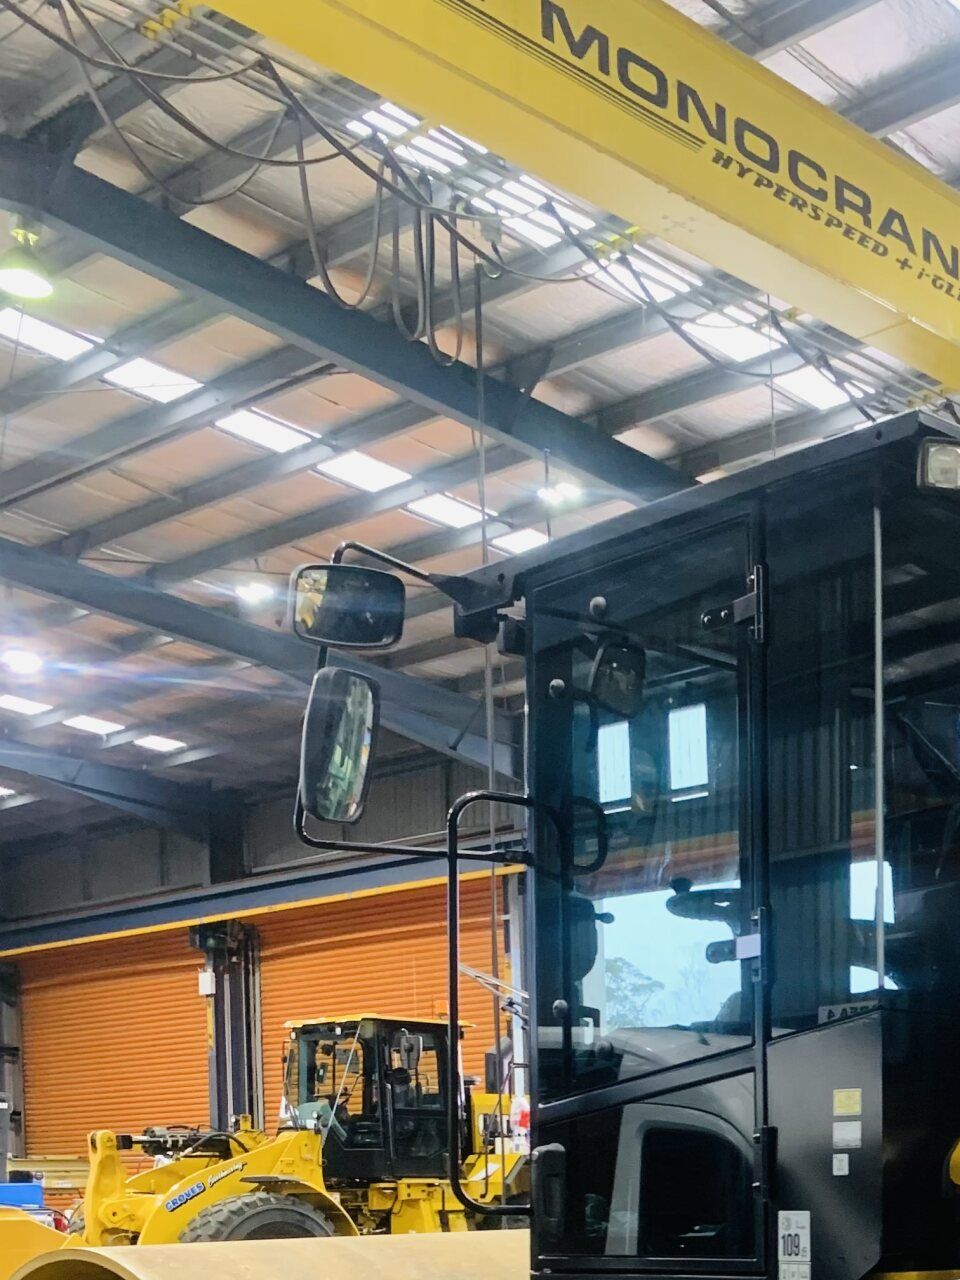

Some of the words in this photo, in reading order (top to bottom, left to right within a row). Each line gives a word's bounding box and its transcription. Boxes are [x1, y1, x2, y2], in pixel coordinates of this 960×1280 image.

[712, 149, 889, 258] HYPERSPEED
[165, 1182, 204, 1211] GROVES
[781, 1233, 800, 1256] 109
